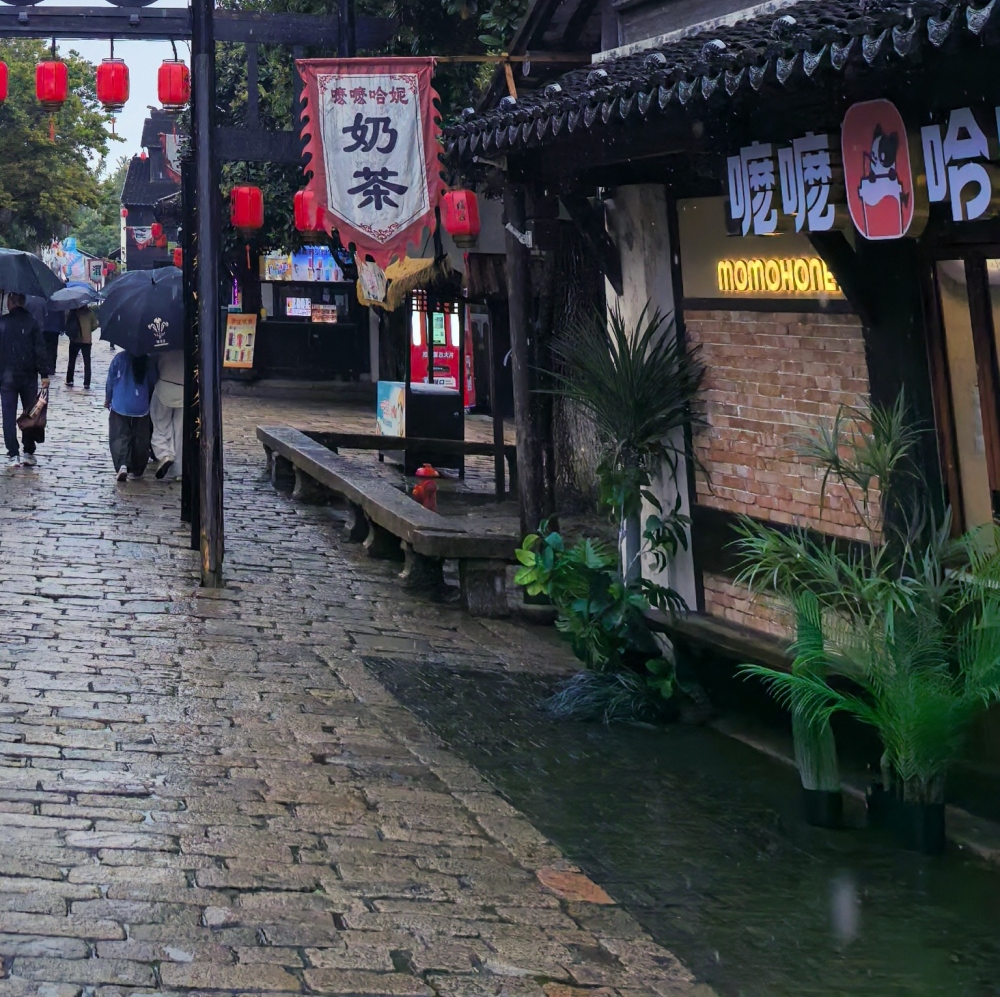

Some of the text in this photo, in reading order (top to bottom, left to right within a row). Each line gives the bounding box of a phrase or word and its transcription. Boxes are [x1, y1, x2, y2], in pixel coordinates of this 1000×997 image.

[341, 112, 409, 211] 奶茶
[920, 106, 1000, 222] 哈
[717, 257, 843, 292] MOMOHONE
